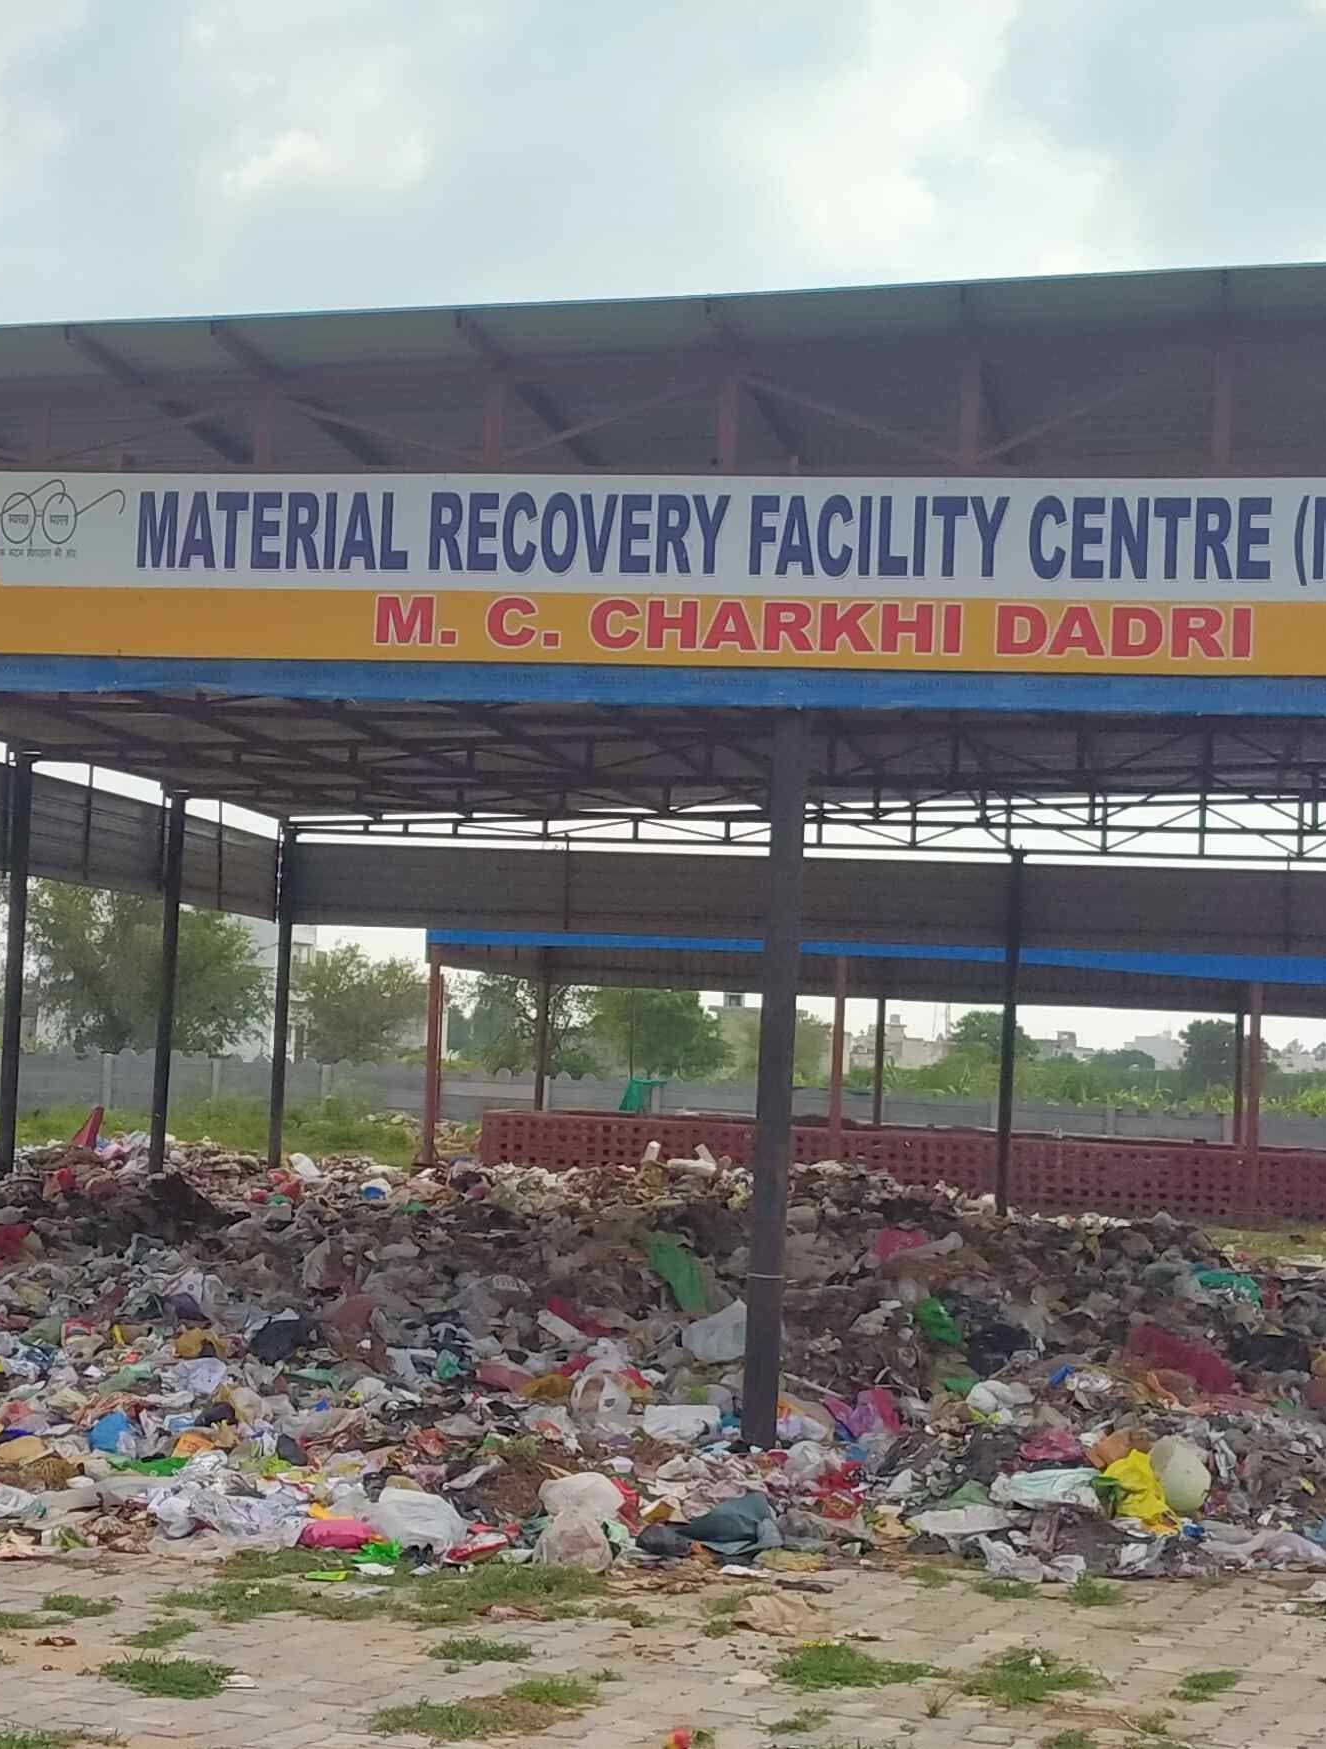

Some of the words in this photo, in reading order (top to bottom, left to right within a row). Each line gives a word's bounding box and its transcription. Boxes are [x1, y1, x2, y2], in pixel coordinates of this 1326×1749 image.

[136, 490, 408, 571] MATERIAL
[428, 491, 731, 575] RECOVERY
[748, 494, 1011, 578] FACILITY
[1028, 495, 1273, 580] CENTRE
[375, 596, 456, 645] M.
[486, 597, 559, 647] C.
[590, 600, 962, 654] CHARKHI
[996, 605, 1253, 659] DADRI
